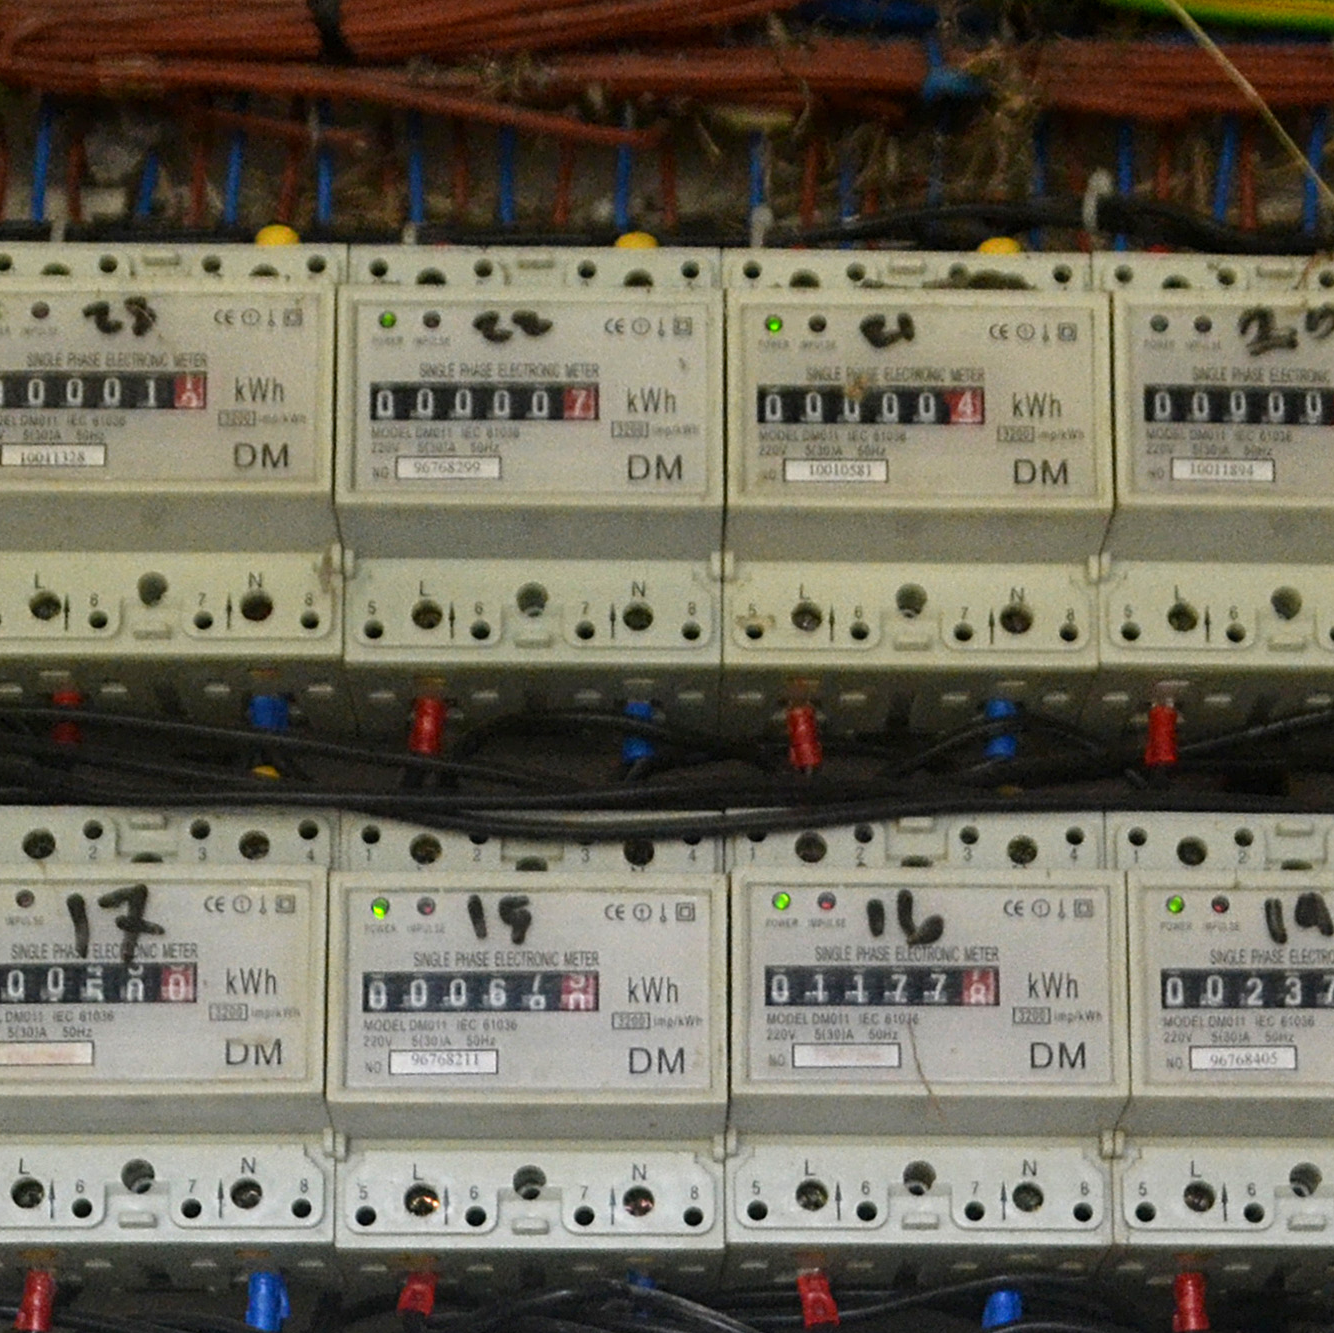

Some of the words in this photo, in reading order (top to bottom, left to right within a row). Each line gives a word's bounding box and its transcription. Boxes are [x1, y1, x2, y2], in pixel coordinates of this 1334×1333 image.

[234, 376, 286, 402] kWh
[375, 384, 593, 418] 000007
[627, 386, 677, 413] kWh
[762, 387, 979, 422] 000004
[1012, 391, 1062, 418] kWh
[232, 442, 289, 468] DM
[627, 454, 682, 481] DM
[1013, 458, 1068, 485] DM
[66, 884, 166, 966] 17
[866, 889, 943, 948] 16
[412, 952, 449, 967] SINGLE
[454, 951, 488, 967] PHASE
[495, 950, 559, 966] ELECTRONIC
[564, 950, 599, 966] METER
[226, 967, 278, 995] kWh
[628, 975, 679, 1003] kWh
[1028, 971, 1079, 999] kWh
[224, 1038, 282, 1065] DM
[628, 1046, 685, 1074] DM
[1029, 1041, 1086, 1069] DM
